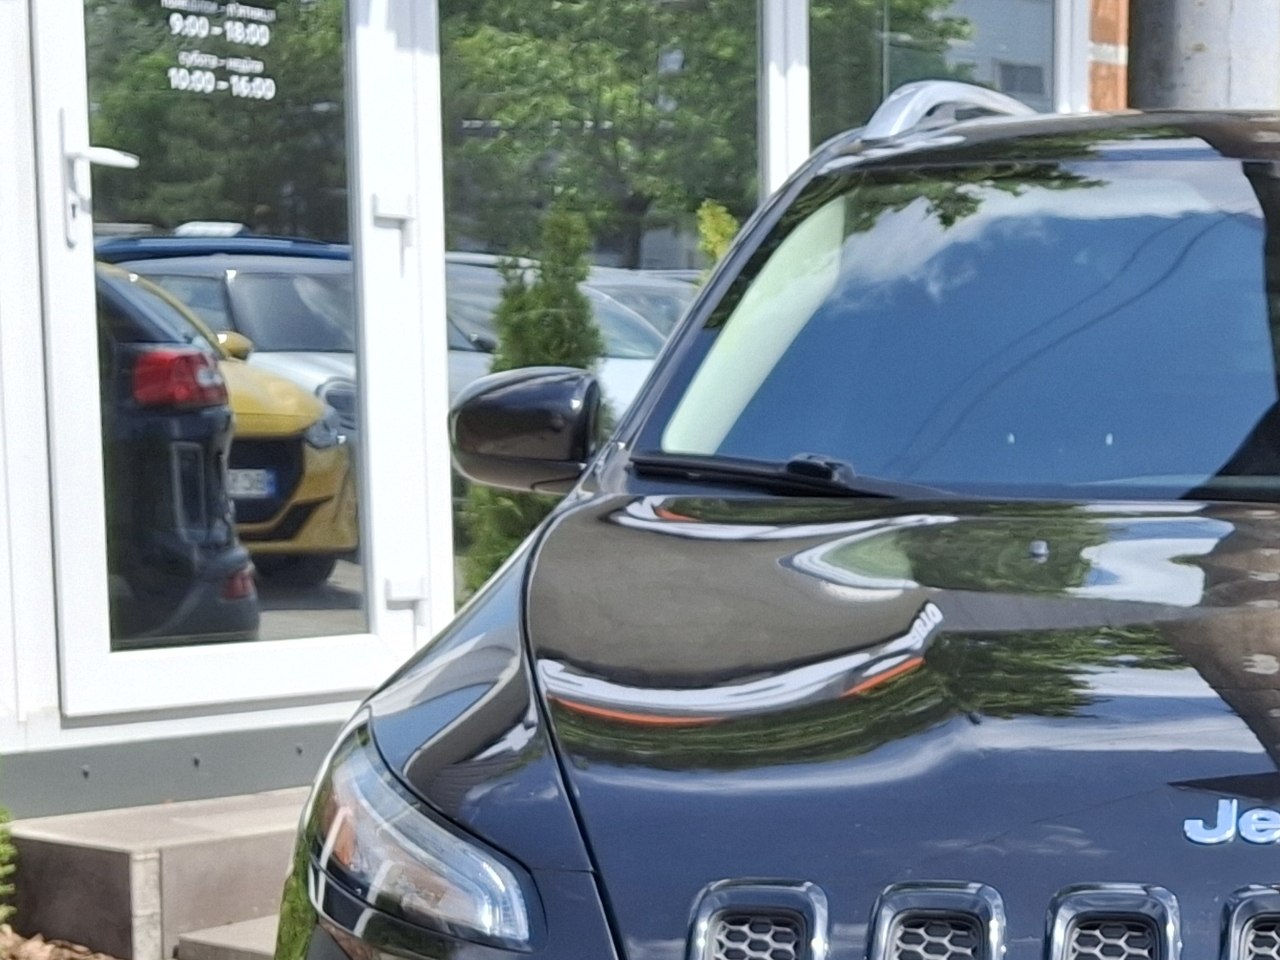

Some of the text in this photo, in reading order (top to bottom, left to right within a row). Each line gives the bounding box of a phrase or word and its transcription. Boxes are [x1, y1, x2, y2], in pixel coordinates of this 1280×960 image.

[169, 12, 209, 38] 9:00
[224, 20, 270, 46] 18:00
[168, 67, 215, 93] 10:00
